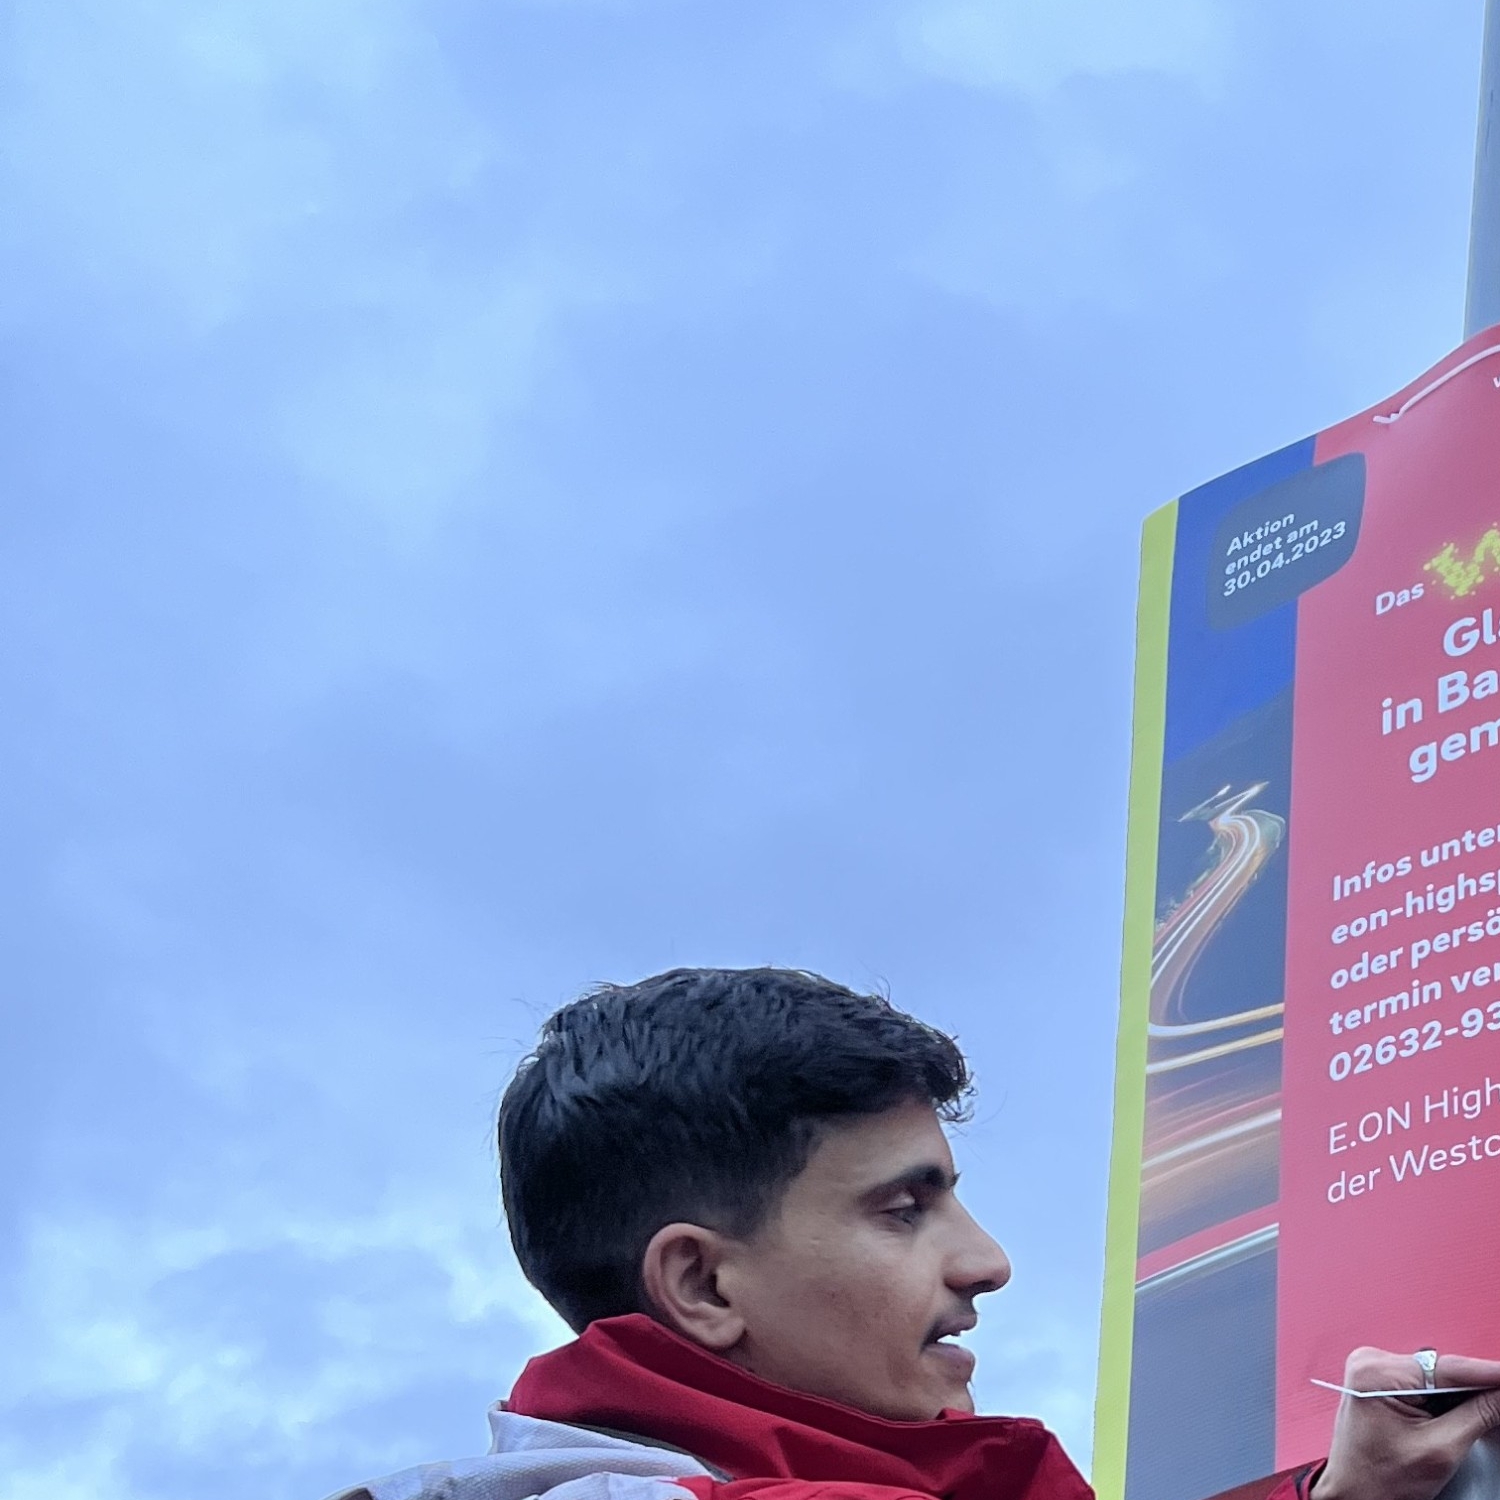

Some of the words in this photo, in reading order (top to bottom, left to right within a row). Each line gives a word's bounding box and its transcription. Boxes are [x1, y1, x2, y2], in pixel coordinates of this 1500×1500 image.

[1225, 536, 1283, 575] endet
[1286, 519, 1319, 544] am
[1226, 513, 1295, 556] Aktion
[1223, 521, 1346, 597] 30.04.2023
[1375, 582, 1425, 616] Das
[1381, 697, 1423, 736] in
[1333, 855, 1413, 902] Infos
[1330, 946, 1404, 989] oder
[1329, 979, 1442, 1035] termin
[1329, 1101, 1411, 1155] E.ON
[1327, 1167, 1381, 1203] der
